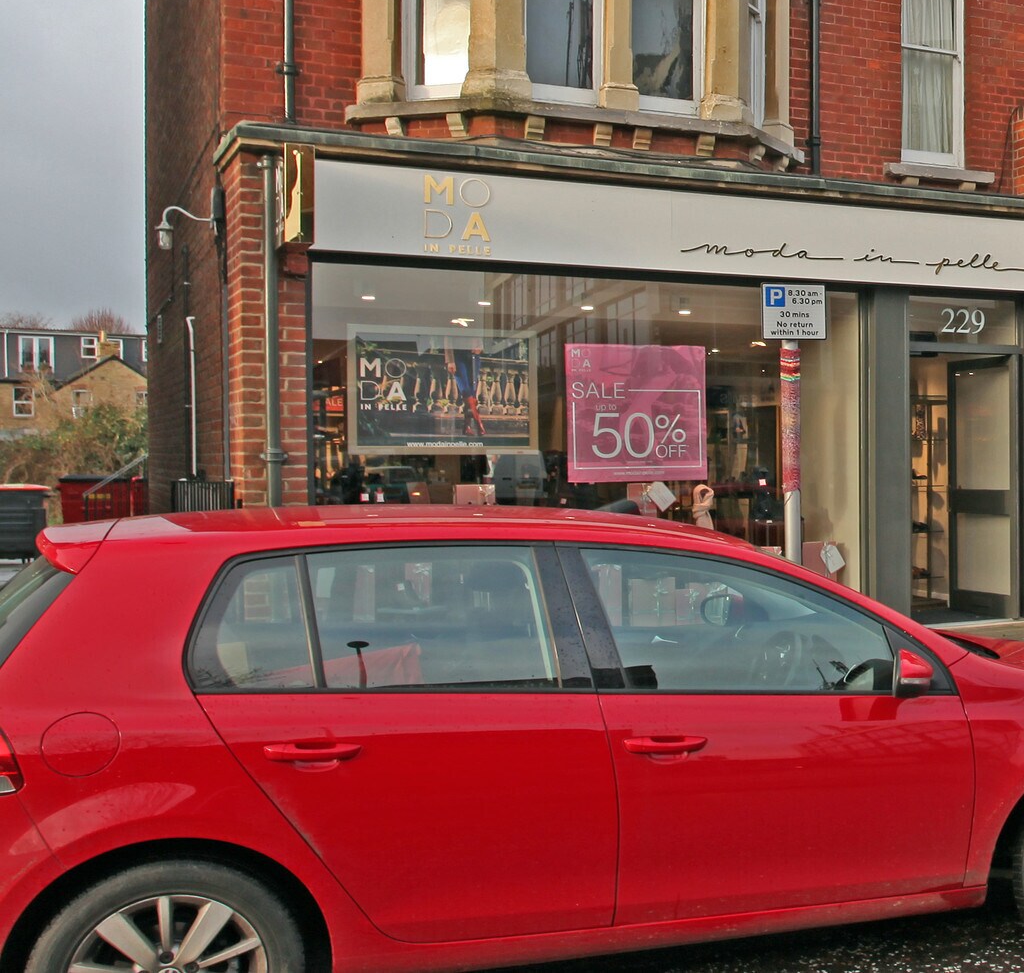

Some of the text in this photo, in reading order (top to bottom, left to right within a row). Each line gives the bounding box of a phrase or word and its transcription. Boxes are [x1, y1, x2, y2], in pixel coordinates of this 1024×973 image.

[424, 243, 492, 256] IN PELLE
[681, 243, 1024, 275] moda in pelle
[940, 308, 986, 335] 229
[572, 382, 625, 399] SALE
[608, 403, 617, 411] to
